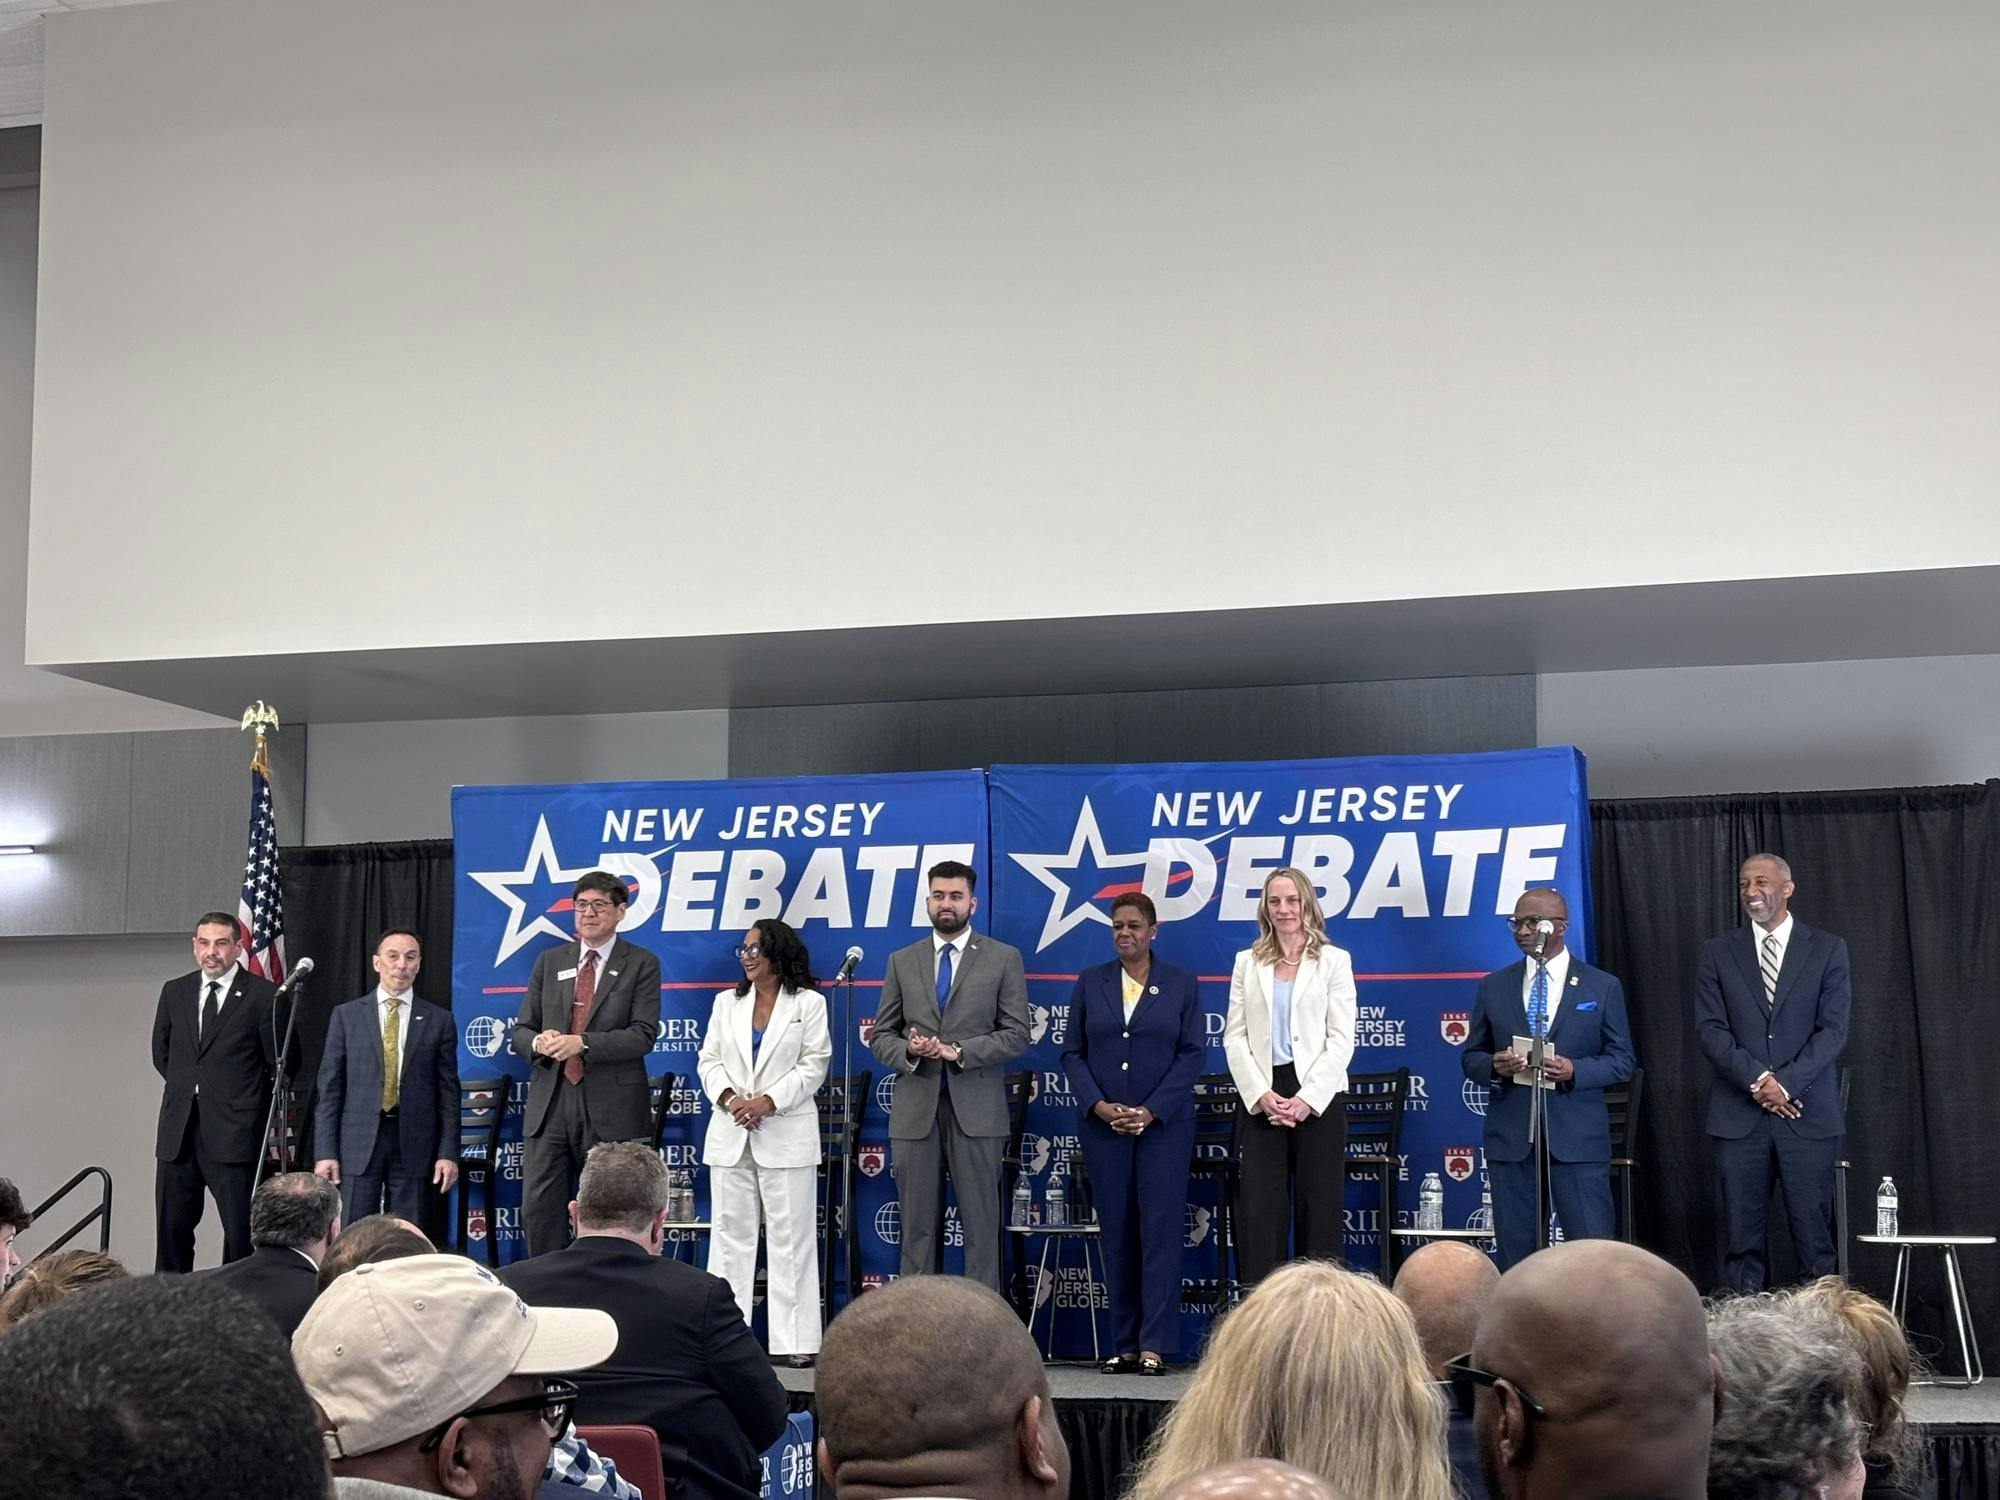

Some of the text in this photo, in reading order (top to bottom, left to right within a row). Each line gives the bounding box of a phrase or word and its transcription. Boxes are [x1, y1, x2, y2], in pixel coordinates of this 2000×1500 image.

[1151, 783, 1464, 828] NEW JERSEY
[602, 802, 885, 843] NEW JERSEY
[1141, 824, 1566, 922] DEBATE
[1051, 1005, 1070, 1018] NE
[1443, 1012, 1467, 1020] 1865
[1355, 1020, 1406, 1033] ERSEY
[653, 1041, 701, 1052] ERSITY
[504, 1142, 524, 1154] NE
[1058, 1267, 1092, 1281] NEW
[1056, 1295, 1110, 1309] GLOBE
